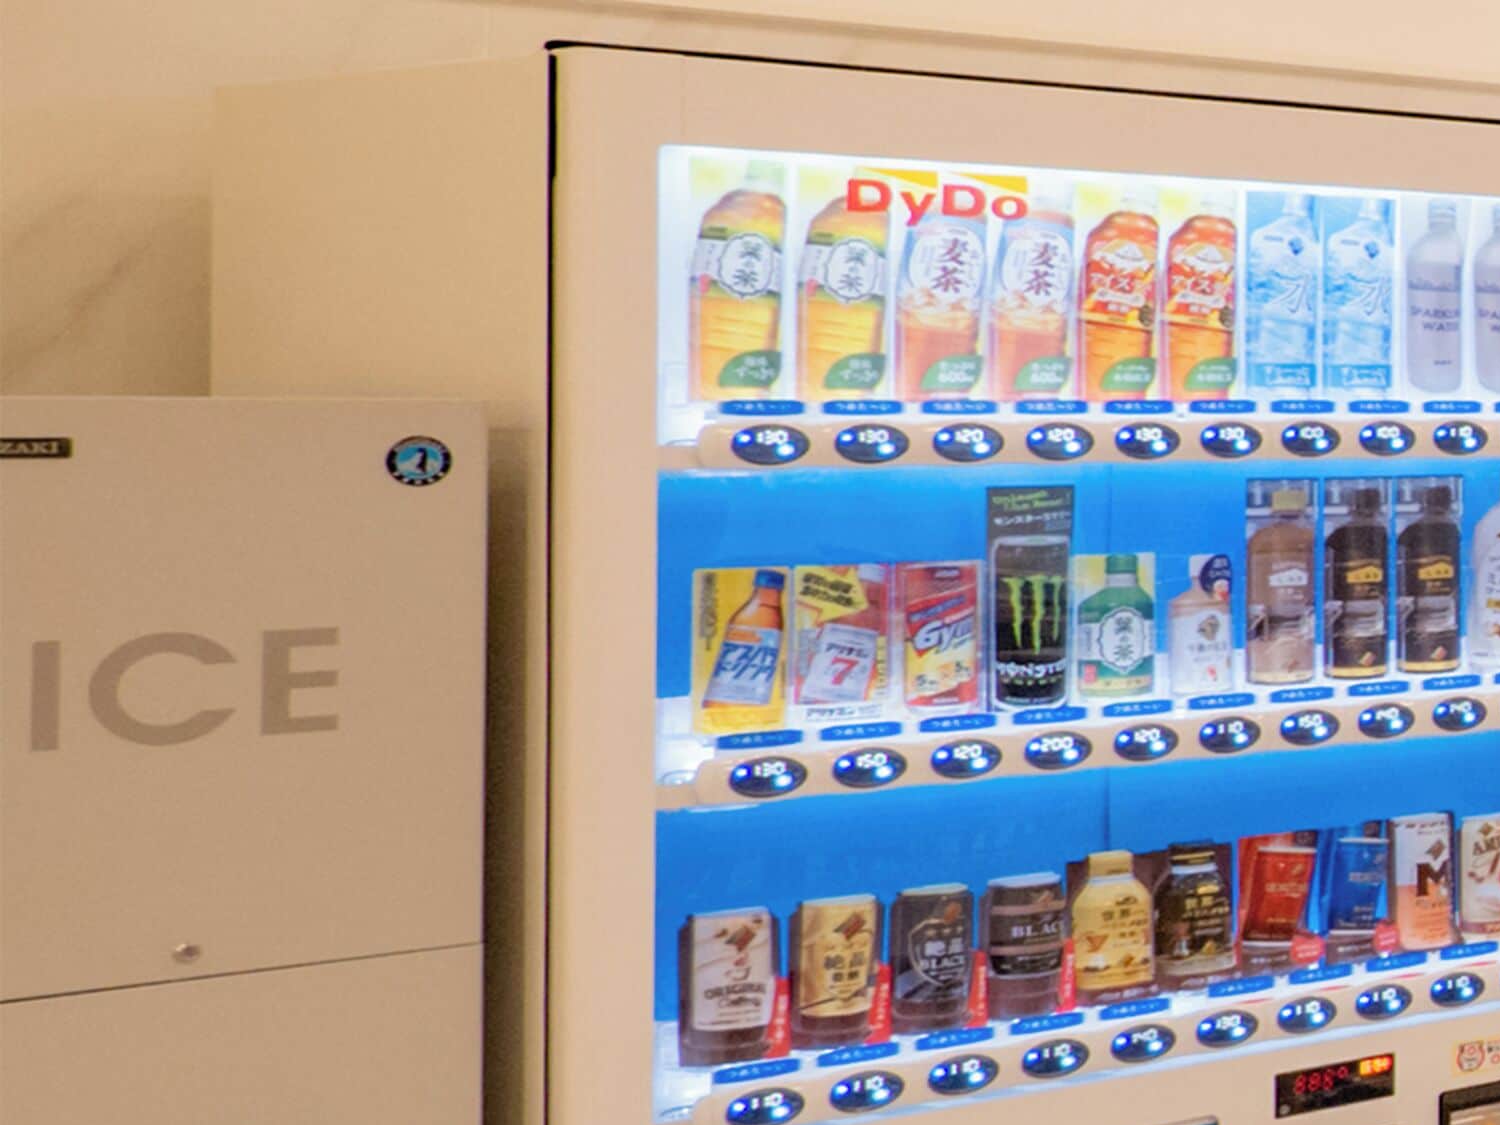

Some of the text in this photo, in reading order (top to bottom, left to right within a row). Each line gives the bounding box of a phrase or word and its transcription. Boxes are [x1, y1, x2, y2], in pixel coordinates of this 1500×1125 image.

[846, 178, 1029, 226] DyDo
[931, 238, 969, 294] 麦茶
[1023, 242, 1058, 296] 麦茶
[29, 627, 339, 753] ICE
[830, 657, 859, 686] 7
